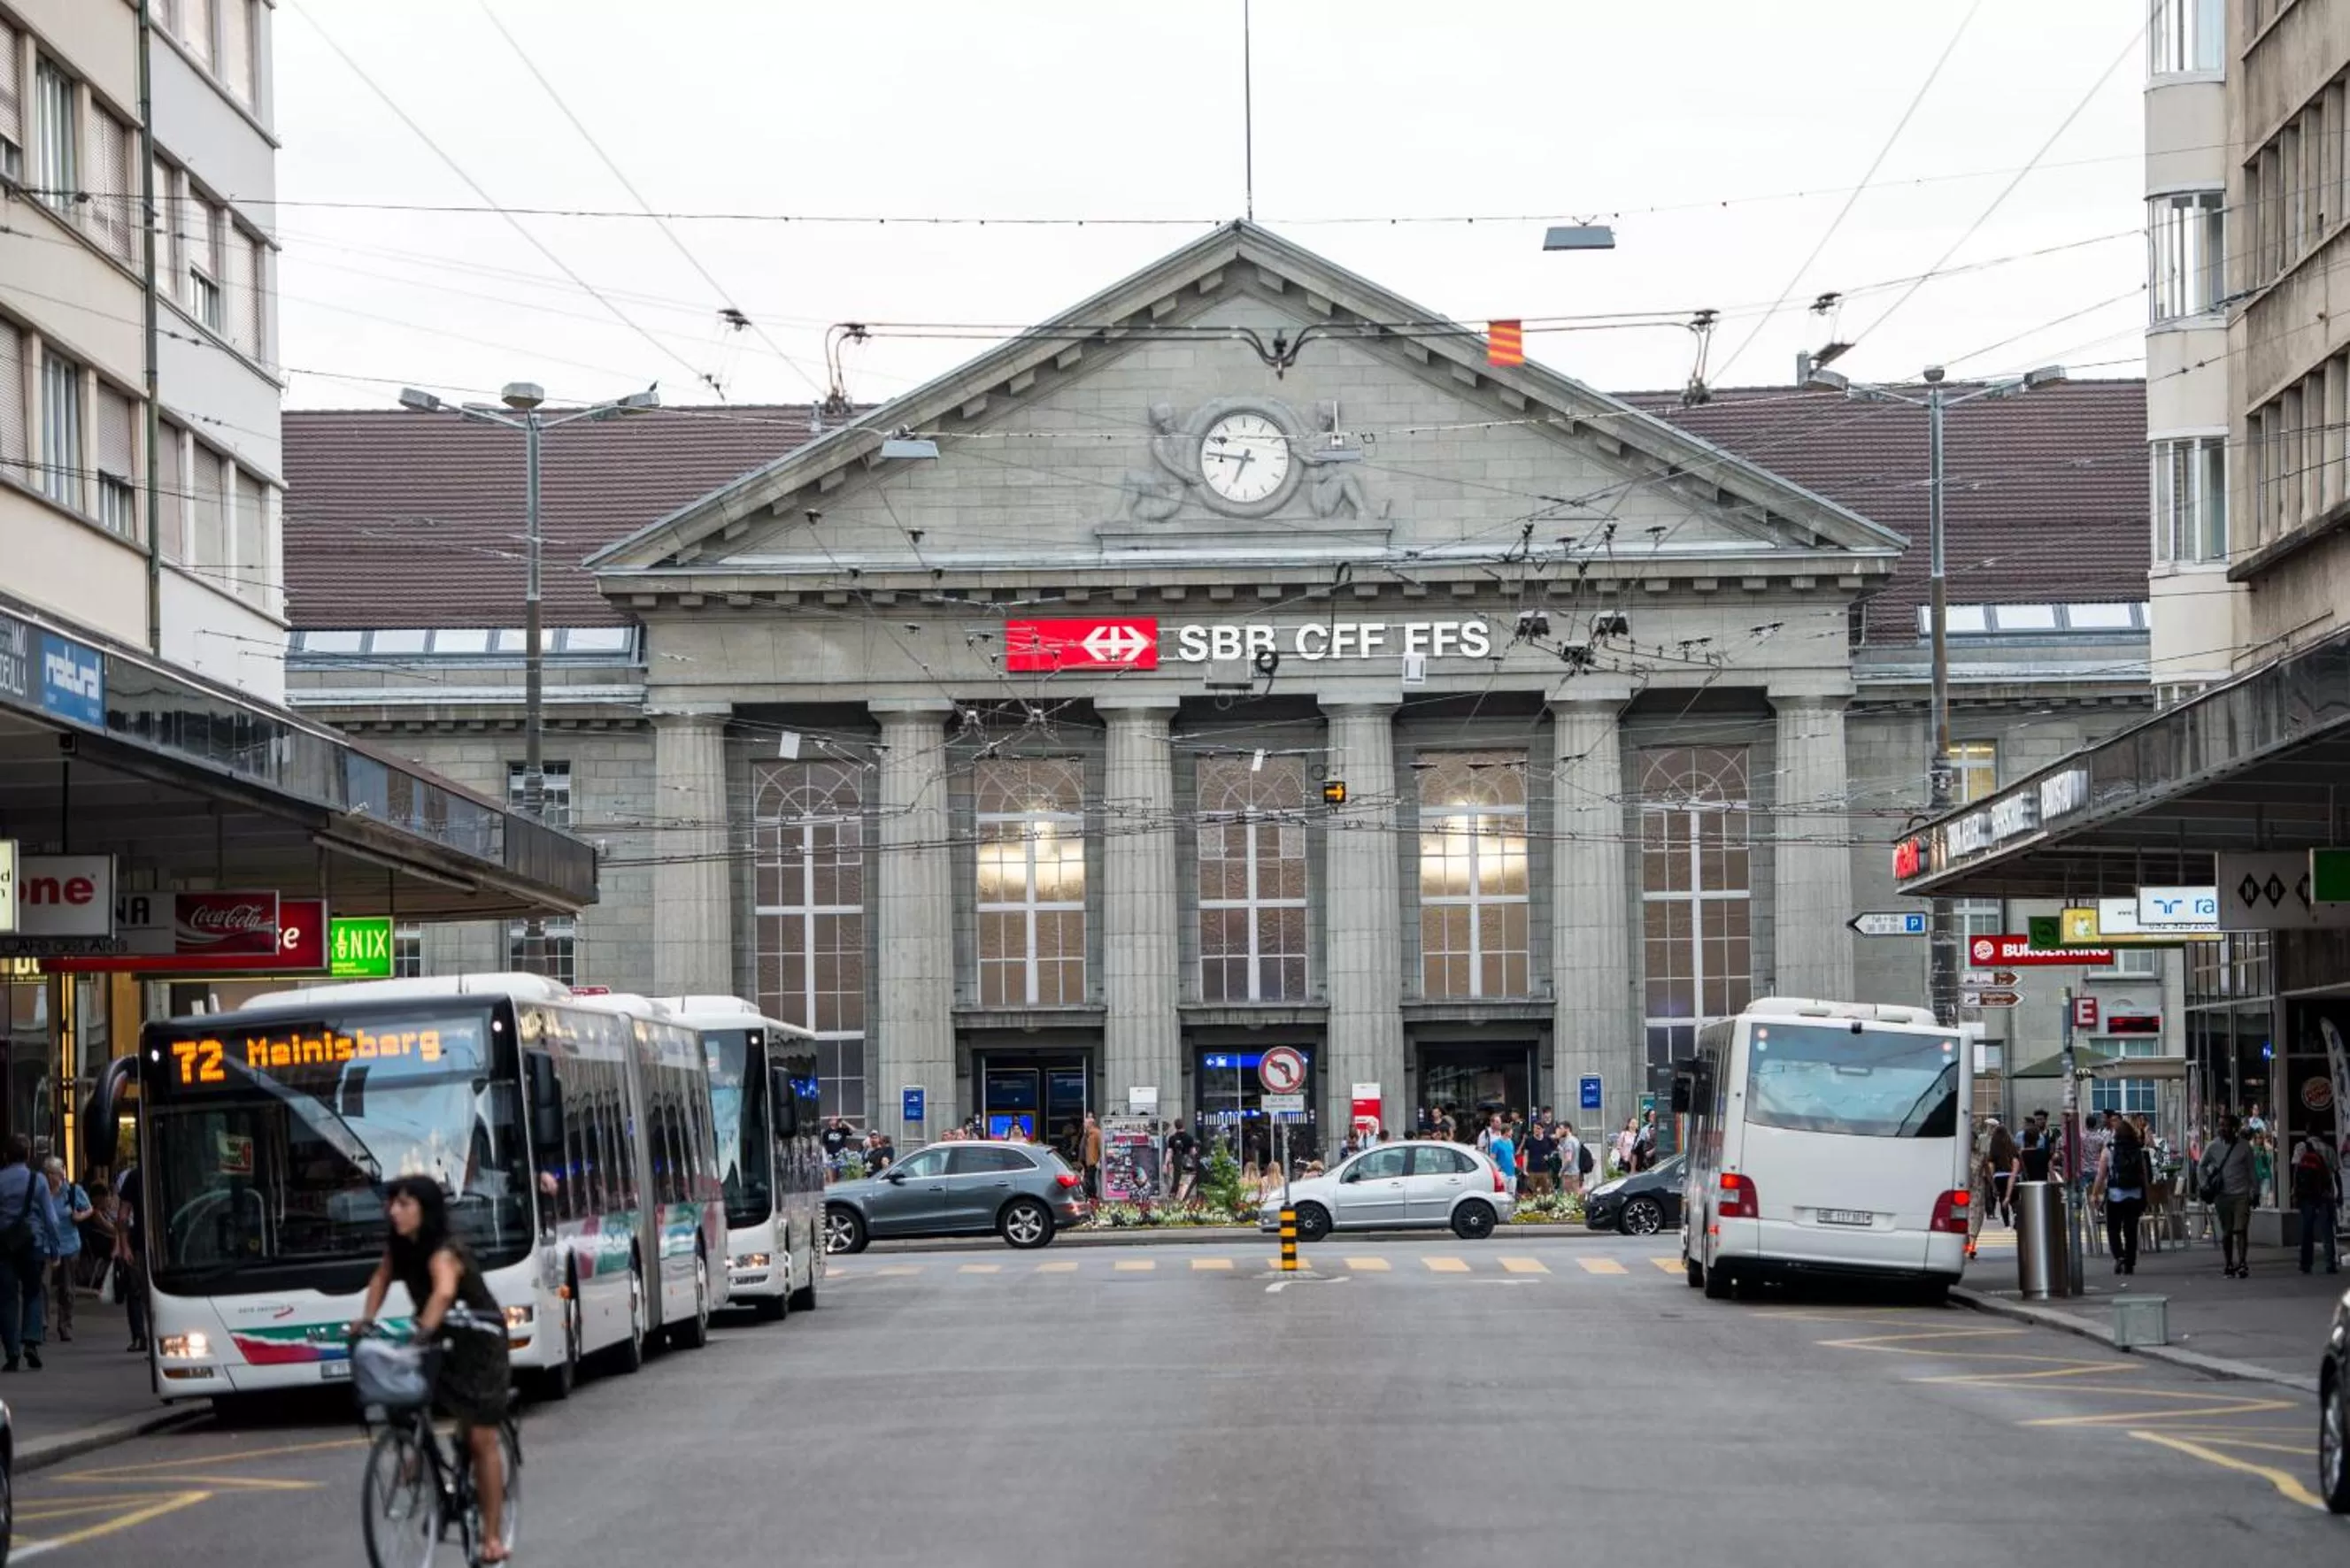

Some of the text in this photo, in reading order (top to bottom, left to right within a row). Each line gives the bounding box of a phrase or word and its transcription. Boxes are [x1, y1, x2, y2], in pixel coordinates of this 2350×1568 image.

[1178, 621, 1491, 662] SBB CFF FFS
[19, 877, 94, 904] ne
[2195, 898, 2215, 914] ra
[1911, 919, 1918, 929] P
[2077, 999, 2095, 1024] E
[172, 1029, 441, 1084] 72 Meinisberg
